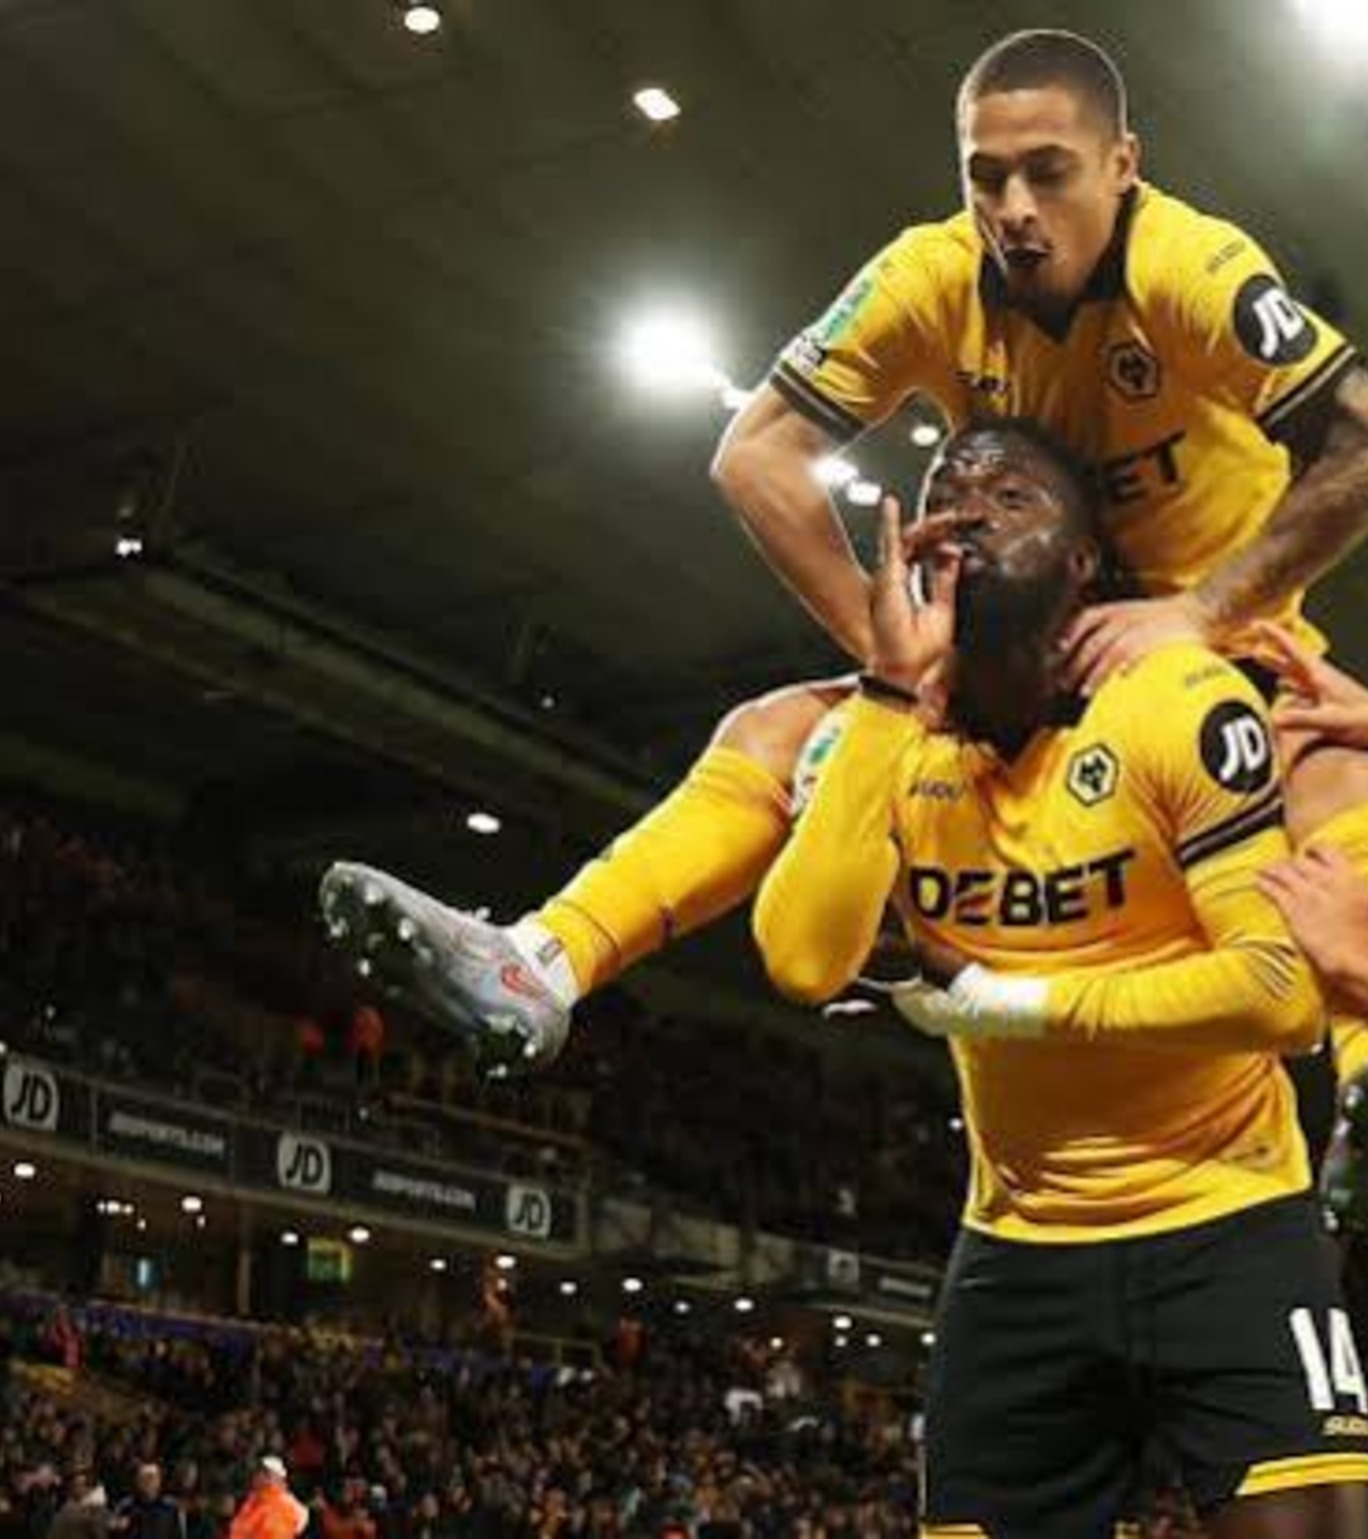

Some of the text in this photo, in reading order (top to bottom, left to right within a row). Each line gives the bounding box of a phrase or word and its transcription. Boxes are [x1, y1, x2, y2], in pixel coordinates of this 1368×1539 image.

[1252, 287, 1305, 358] JD
[1221, 714, 1267, 781] JD
[909, 847, 1135, 926] DEBET
[1288, 1306, 1368, 1414] 14
